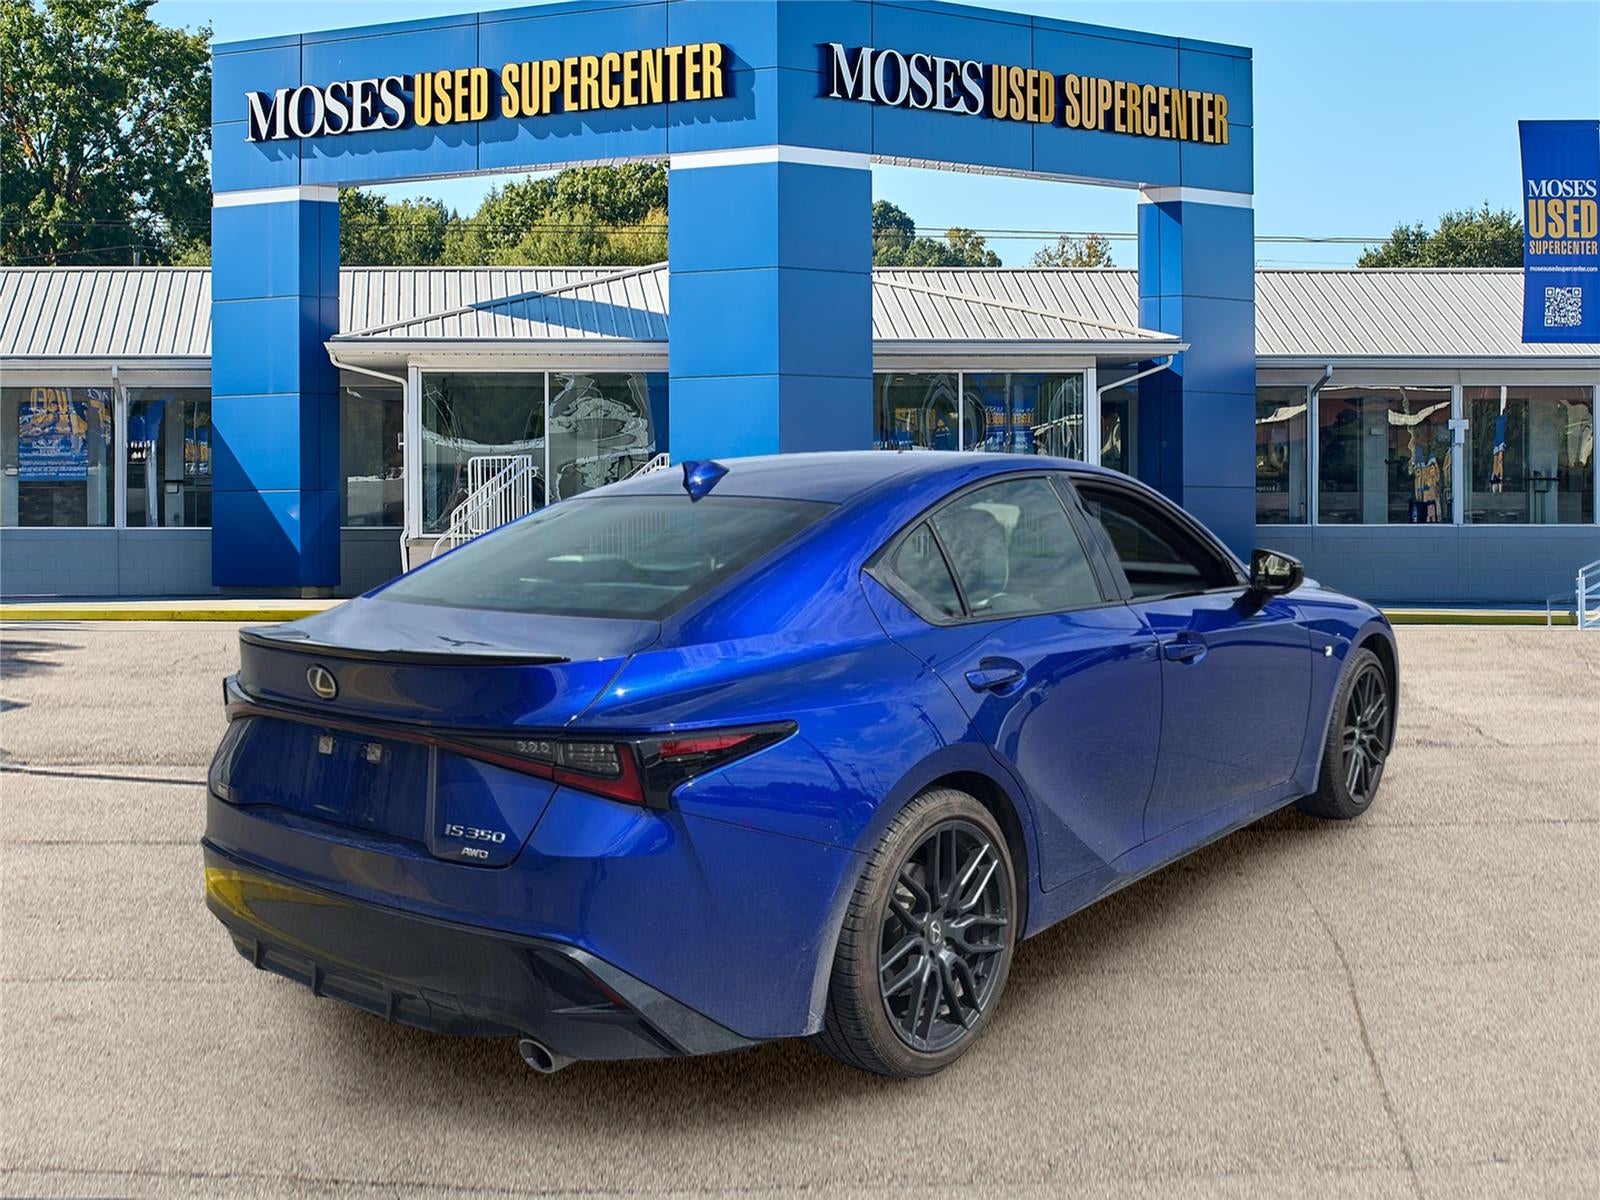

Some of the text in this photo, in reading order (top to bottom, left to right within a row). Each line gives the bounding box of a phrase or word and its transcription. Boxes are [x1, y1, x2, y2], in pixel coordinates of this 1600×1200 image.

[244, 42, 725, 142] MOSES USED SUPERCENTER
[829, 42, 1229, 145] MOSES USED SUPERCENTER
[1528, 179, 1597, 198] MOSES
[1528, 198, 1598, 239] USED
[1529, 240, 1598, 255] SUPERCENTER
[461, 847, 489, 859] AWD
